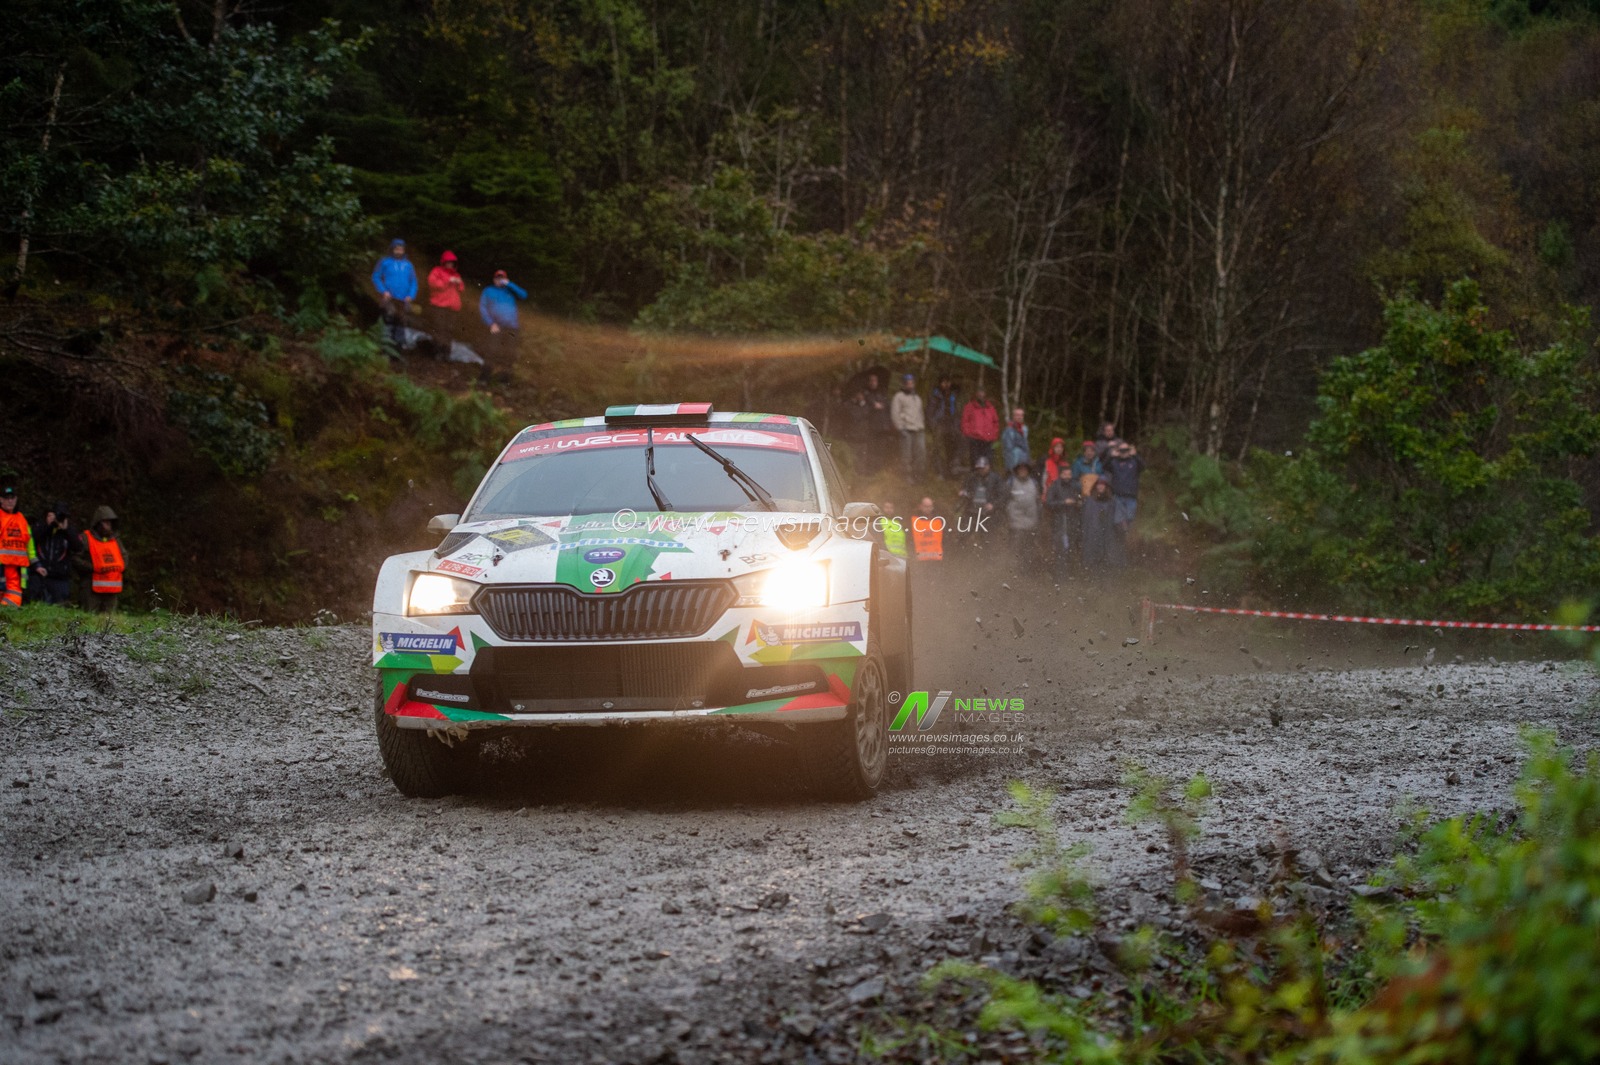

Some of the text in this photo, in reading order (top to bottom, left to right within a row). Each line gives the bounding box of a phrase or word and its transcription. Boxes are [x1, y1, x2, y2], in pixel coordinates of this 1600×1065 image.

[519, 445, 541, 454] WRC
[549, 537, 684, 551] infinitum
[783, 625, 856, 639] MICHELIN
[397, 637, 453, 649] MICHELIN
